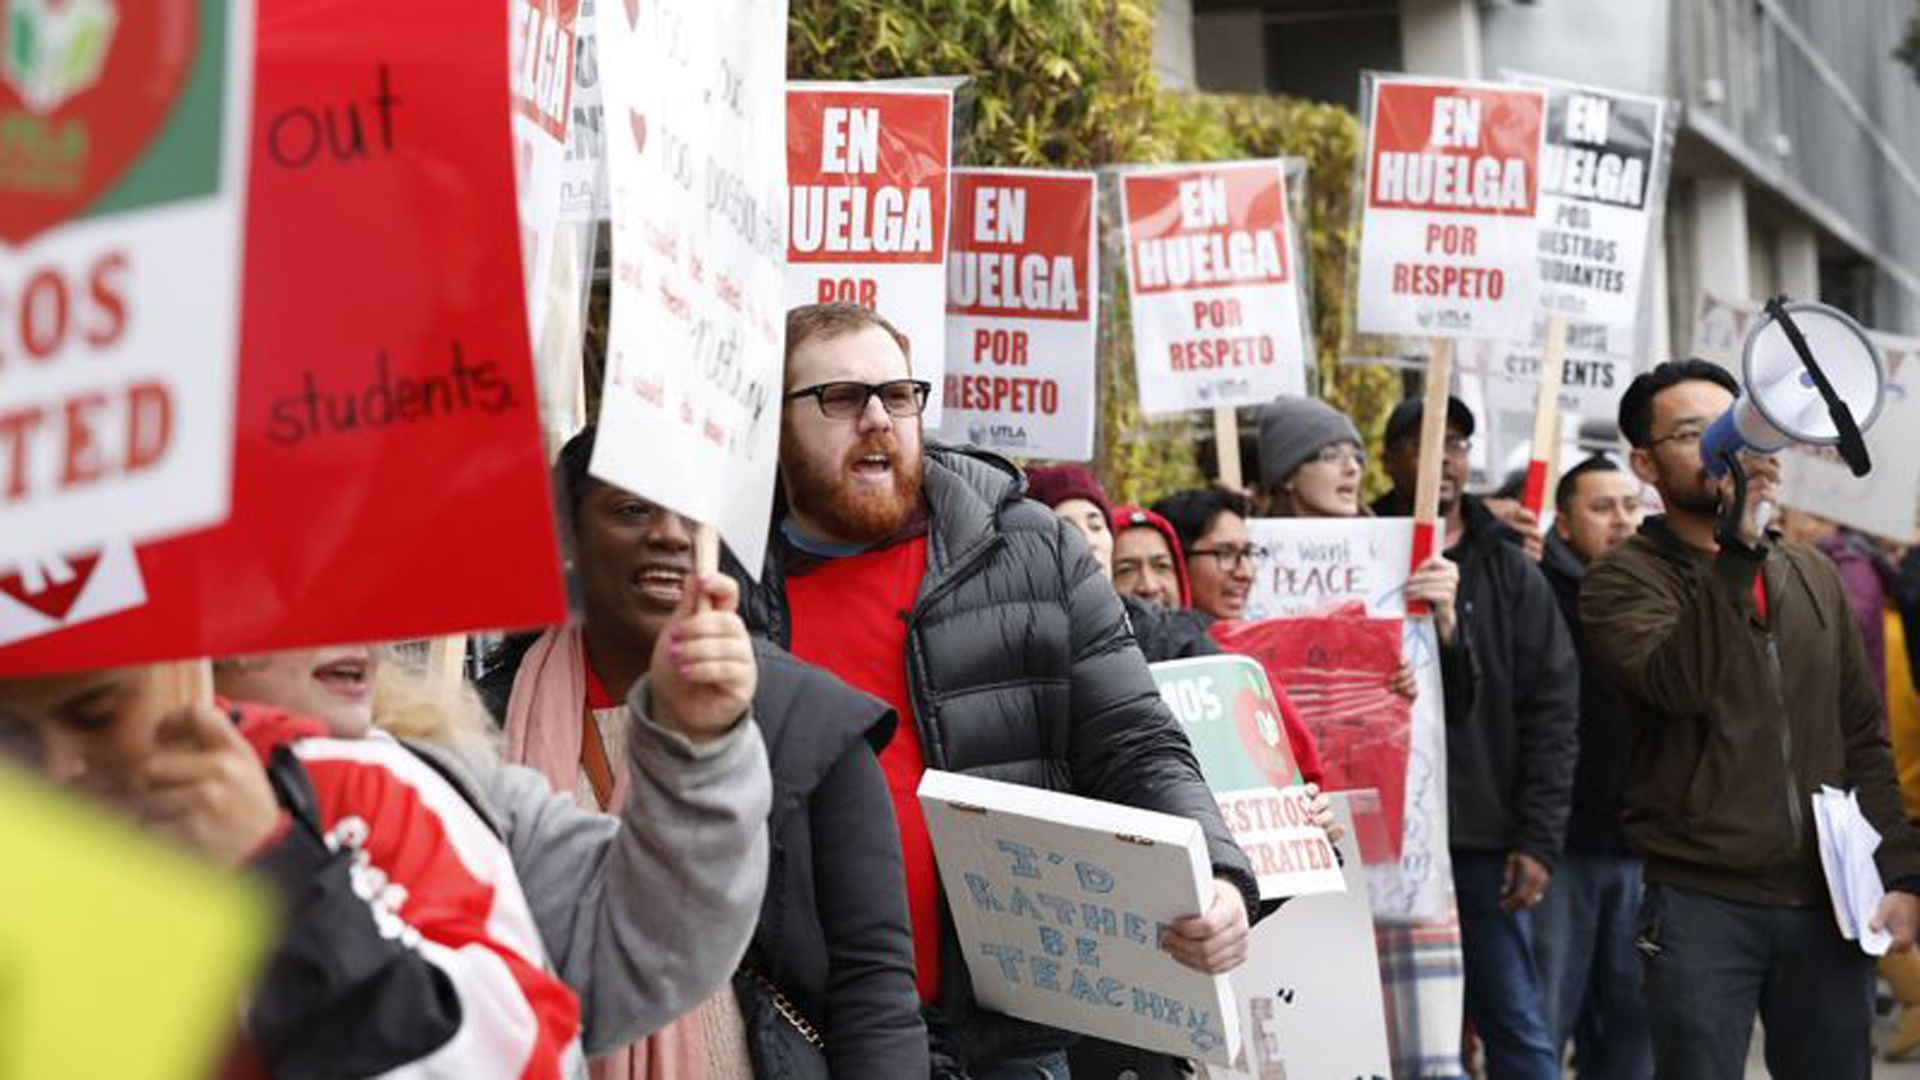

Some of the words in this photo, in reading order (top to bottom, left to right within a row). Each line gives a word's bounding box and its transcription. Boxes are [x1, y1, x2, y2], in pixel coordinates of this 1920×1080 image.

[268, 62, 402, 169] out
[821, 107, 879, 174] EN
[1432, 96, 1482, 150] EN
[1567, 93, 1609, 146] EN
[1378, 152, 1528, 208] HUELGA
[1544, 145, 1643, 207] UELGA
[790, 185, 933, 253] UELGA
[974, 187, 1027, 244] EN
[1179, 178, 1230, 231] EN
[1136, 228, 1283, 287] HUELGA
[1426, 223, 1478, 256] POR
[0, 248, 132, 368] OS
[949, 251, 1079, 312] UELGA
[1392, 262, 1504, 301] RESPETO
[1193, 298, 1242, 330] POR
[974, 329, 1028, 365] POR
[1169, 335, 1275, 373] RESPETO
[267, 338, 513, 446] students
[943, 374, 1058, 416] RESPETO
[1273, 566, 1370, 596] PEACE
[999, 840, 1115, 894] I'D
[1038, 923, 1100, 968] BE
